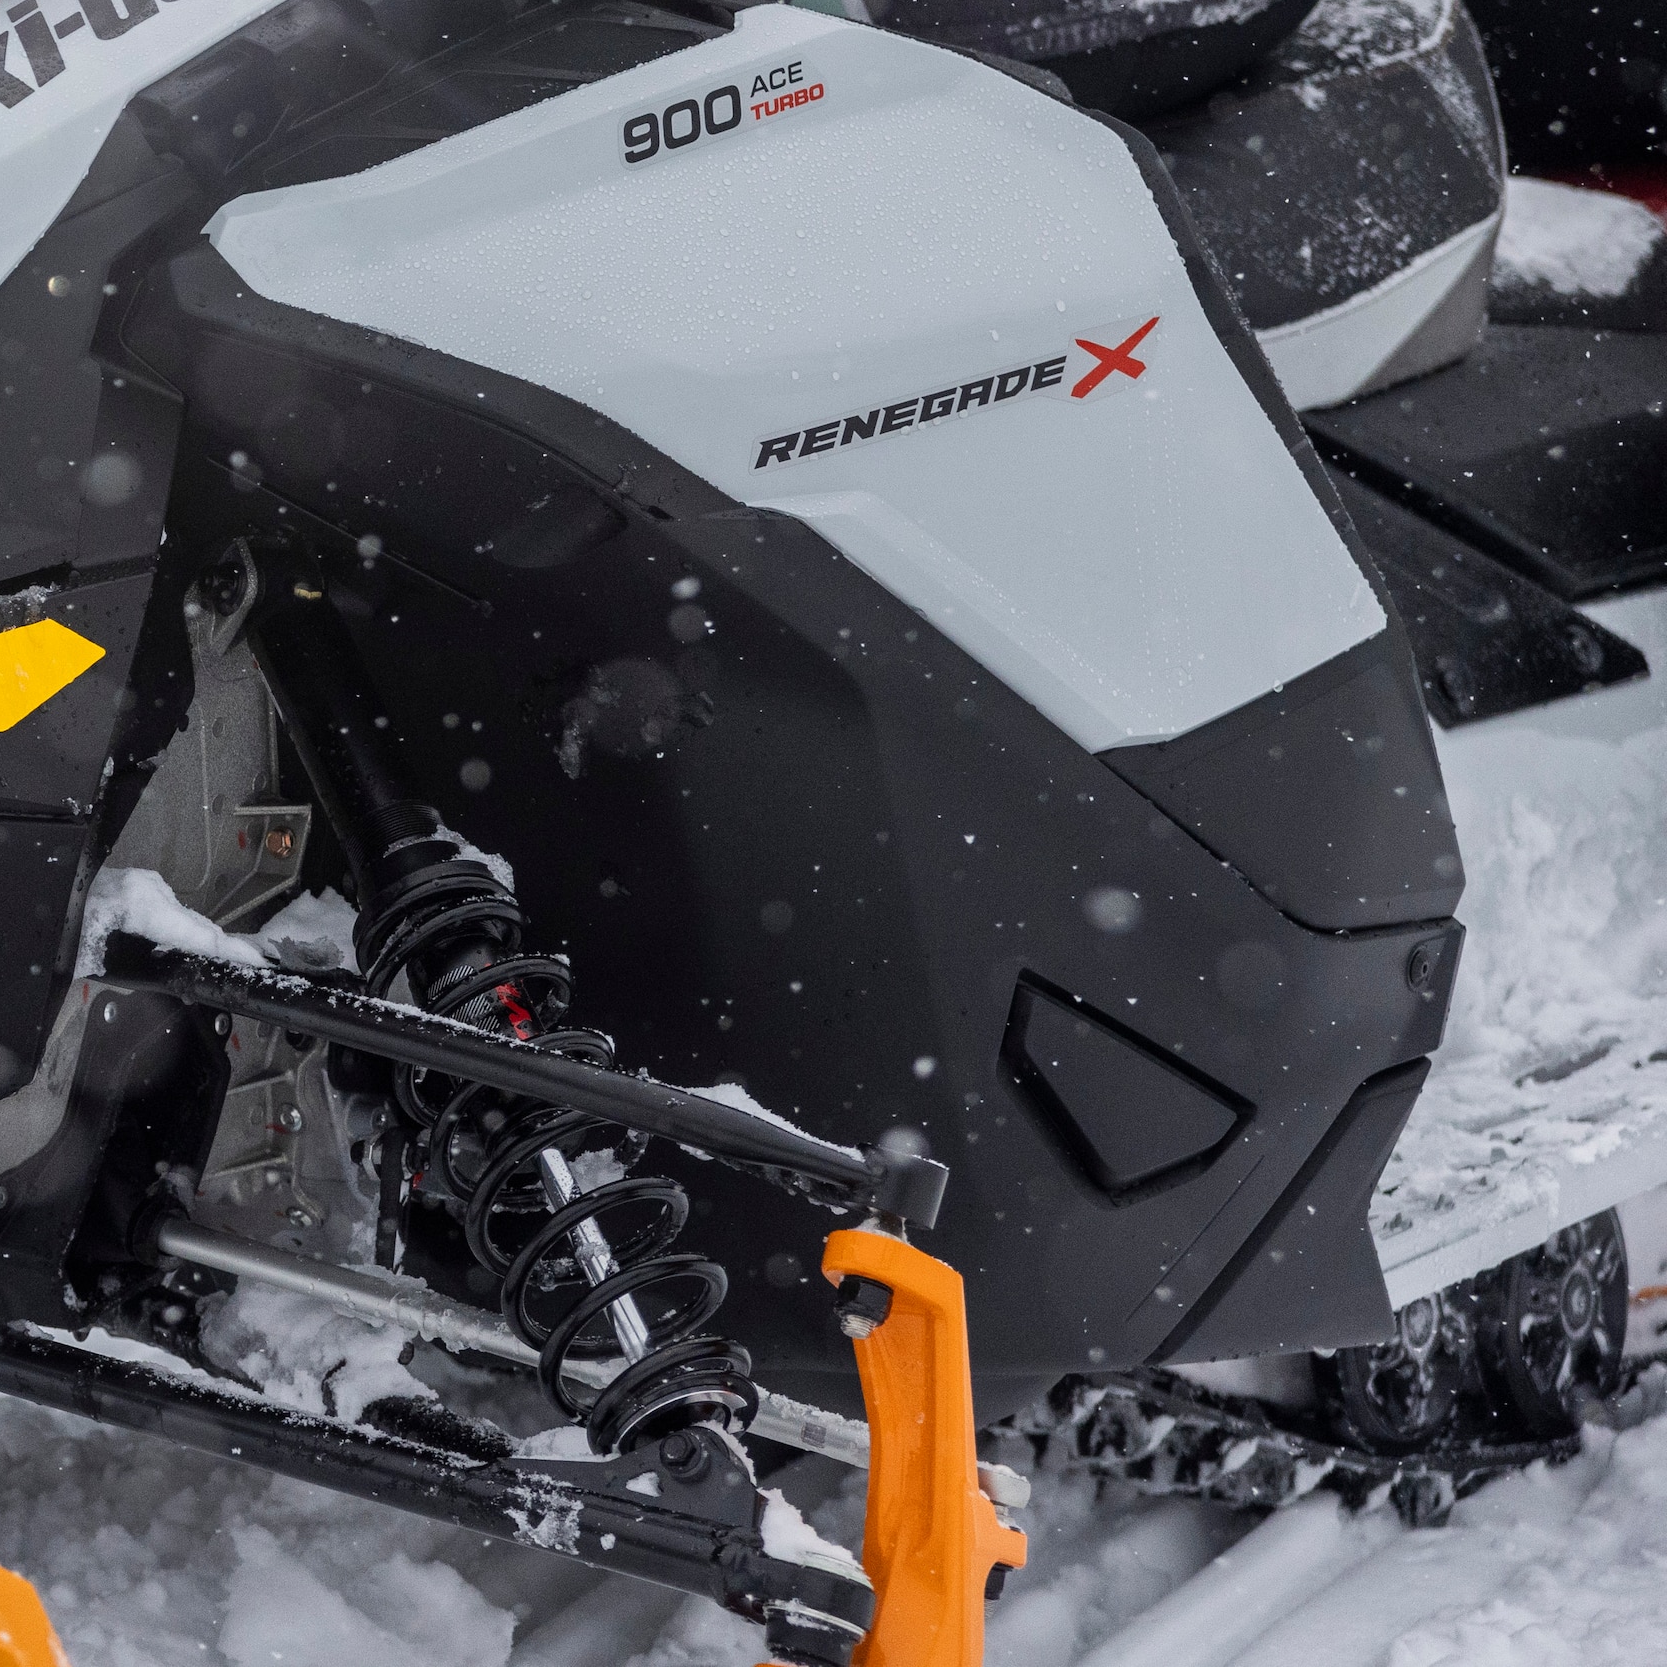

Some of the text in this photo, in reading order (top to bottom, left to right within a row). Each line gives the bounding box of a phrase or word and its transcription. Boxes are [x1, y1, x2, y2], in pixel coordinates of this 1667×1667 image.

[624, 61, 804, 164] 900 ACE
[750, 83, 824, 120] TURBO
[754, 316, 1161, 470] RENEGADE X
